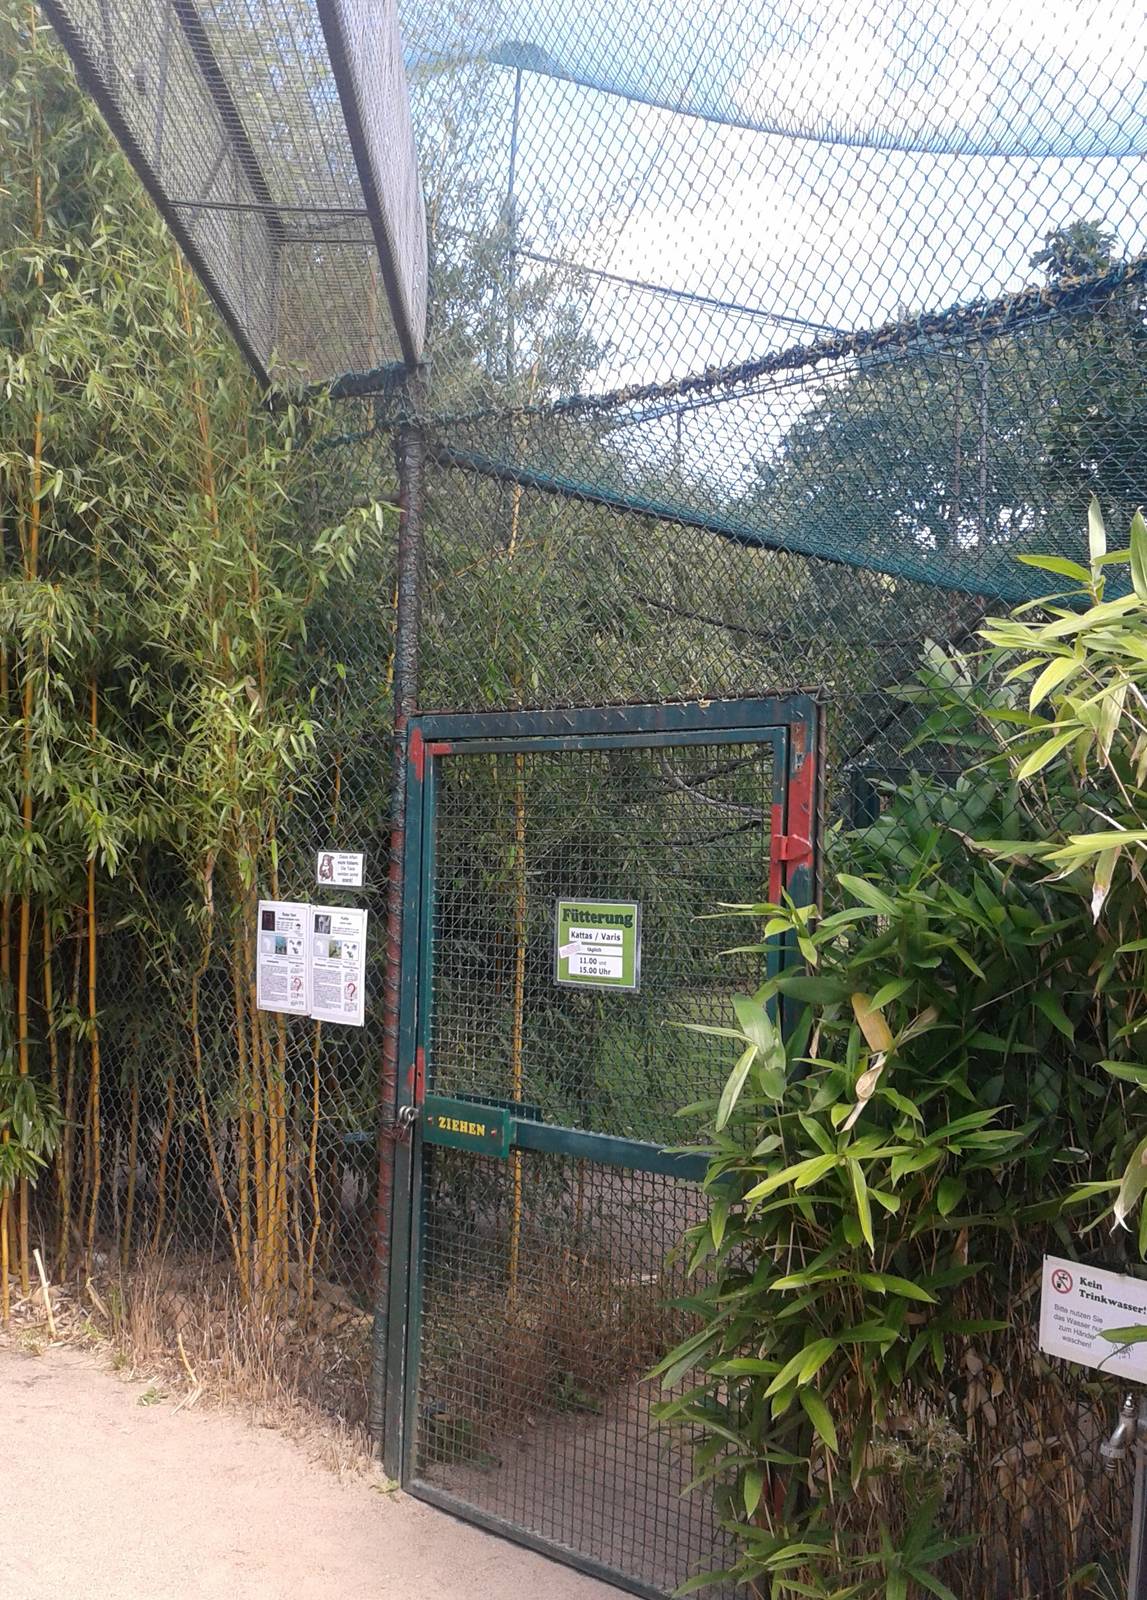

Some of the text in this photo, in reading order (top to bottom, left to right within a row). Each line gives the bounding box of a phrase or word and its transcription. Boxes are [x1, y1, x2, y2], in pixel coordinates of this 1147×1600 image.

[562, 908, 633, 928] Fütterung
[571, 931, 593, 940] Kattas
[601, 933, 621, 941] Varis
[580, 957, 597, 965] 11.00
[438, 1116, 486, 1137] ZIEHEN
[1079, 1276, 1103, 1291] Kein
[1079, 1289, 1147, 1315] Trinkwasser!
[1054, 1303, 1103, 1324] Bitte nutzen Sie
[1053, 1314, 1065, 1322] das
[1066, 1317, 1090, 1329] Wasser
[1058, 1325, 1072, 1333] zum
[1062, 1336, 1092, 1348] waschen!
